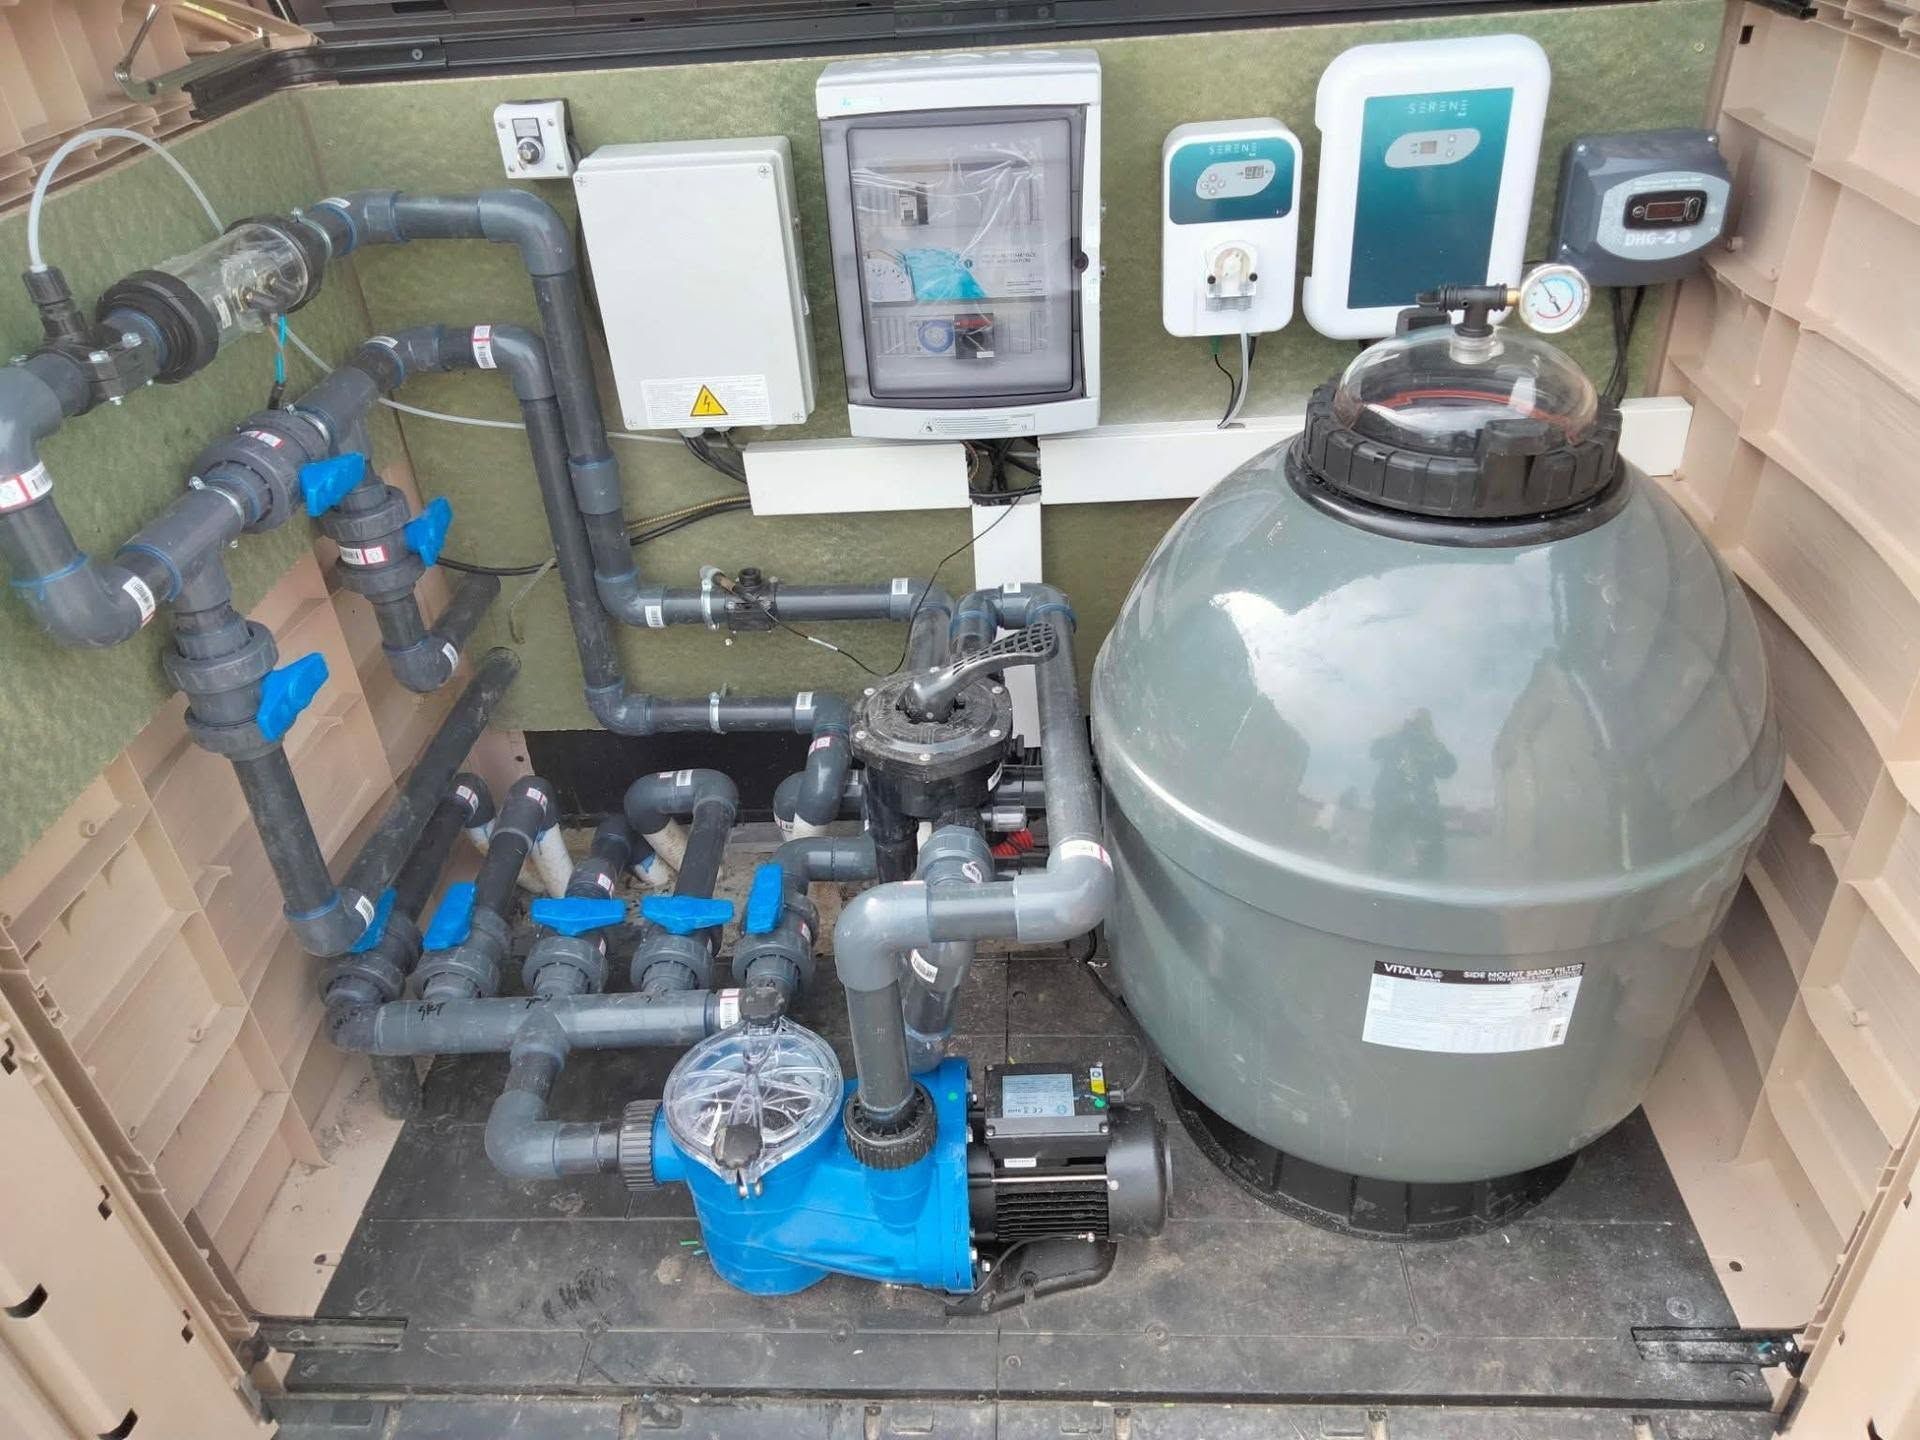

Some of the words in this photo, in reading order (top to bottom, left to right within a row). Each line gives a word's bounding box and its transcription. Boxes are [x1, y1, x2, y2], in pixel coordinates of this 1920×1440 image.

[1408, 100, 1468, 114] SERENE
[1208, 142, 1257, 155] SERENE
[1384, 963, 1433, 977] VITALIA
[1463, 971, 1486, 979] SIDE
[1526, 969, 1552, 977] SAND
